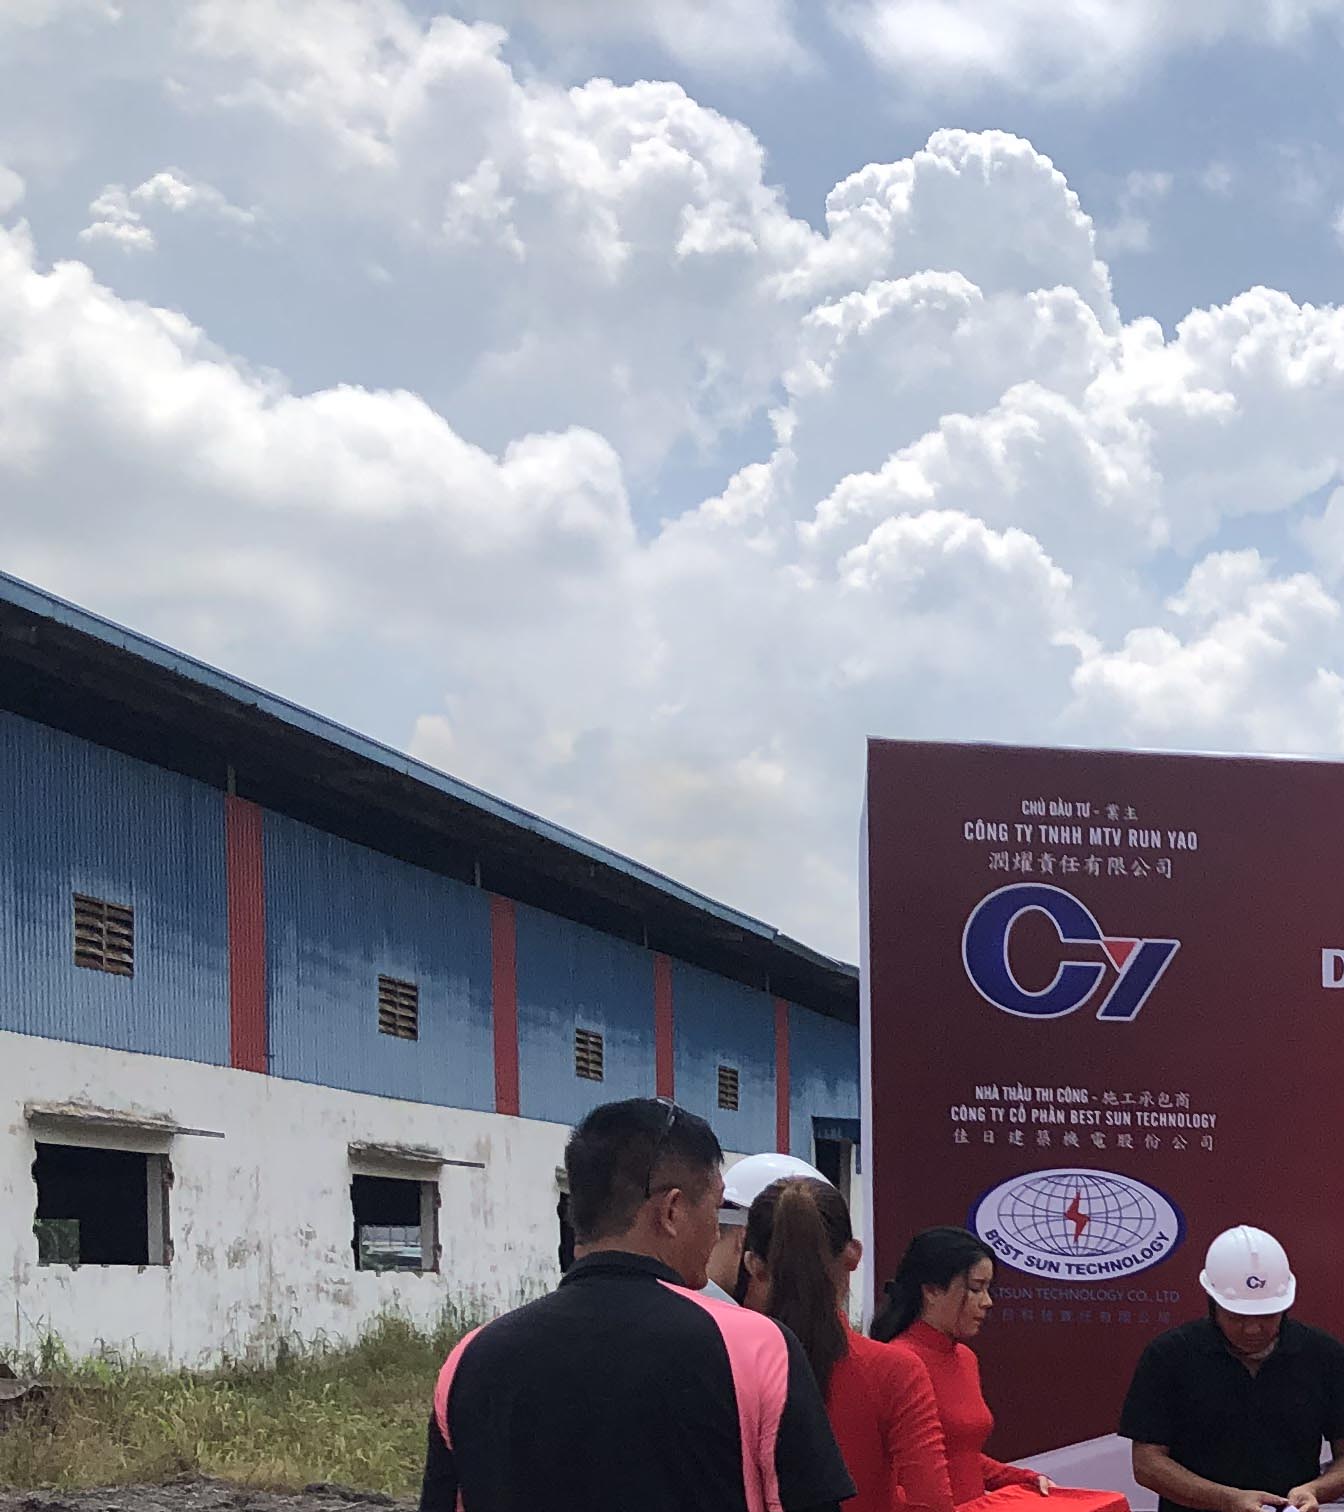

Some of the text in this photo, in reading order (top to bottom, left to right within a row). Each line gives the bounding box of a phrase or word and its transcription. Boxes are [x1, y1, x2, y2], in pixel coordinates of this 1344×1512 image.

[964, 818, 1198, 850] CÔNG TY TNHH MTV RUN YAO
[975, 1083, 1000, 1101] NHÀ
[1057, 1086, 1088, 1104] CÔNG
[951, 1103, 986, 1121] CÔNG
[990, 1107, 1006, 1123] TY
[1070, 1110, 1101, 1125] BEST
[1105, 1111, 1131, 1126] SUN
[1136, 1112, 1217, 1129] TECHNOLOGY
[985, 1228, 1171, 1275] BEST SUN TECHNOLOGY
